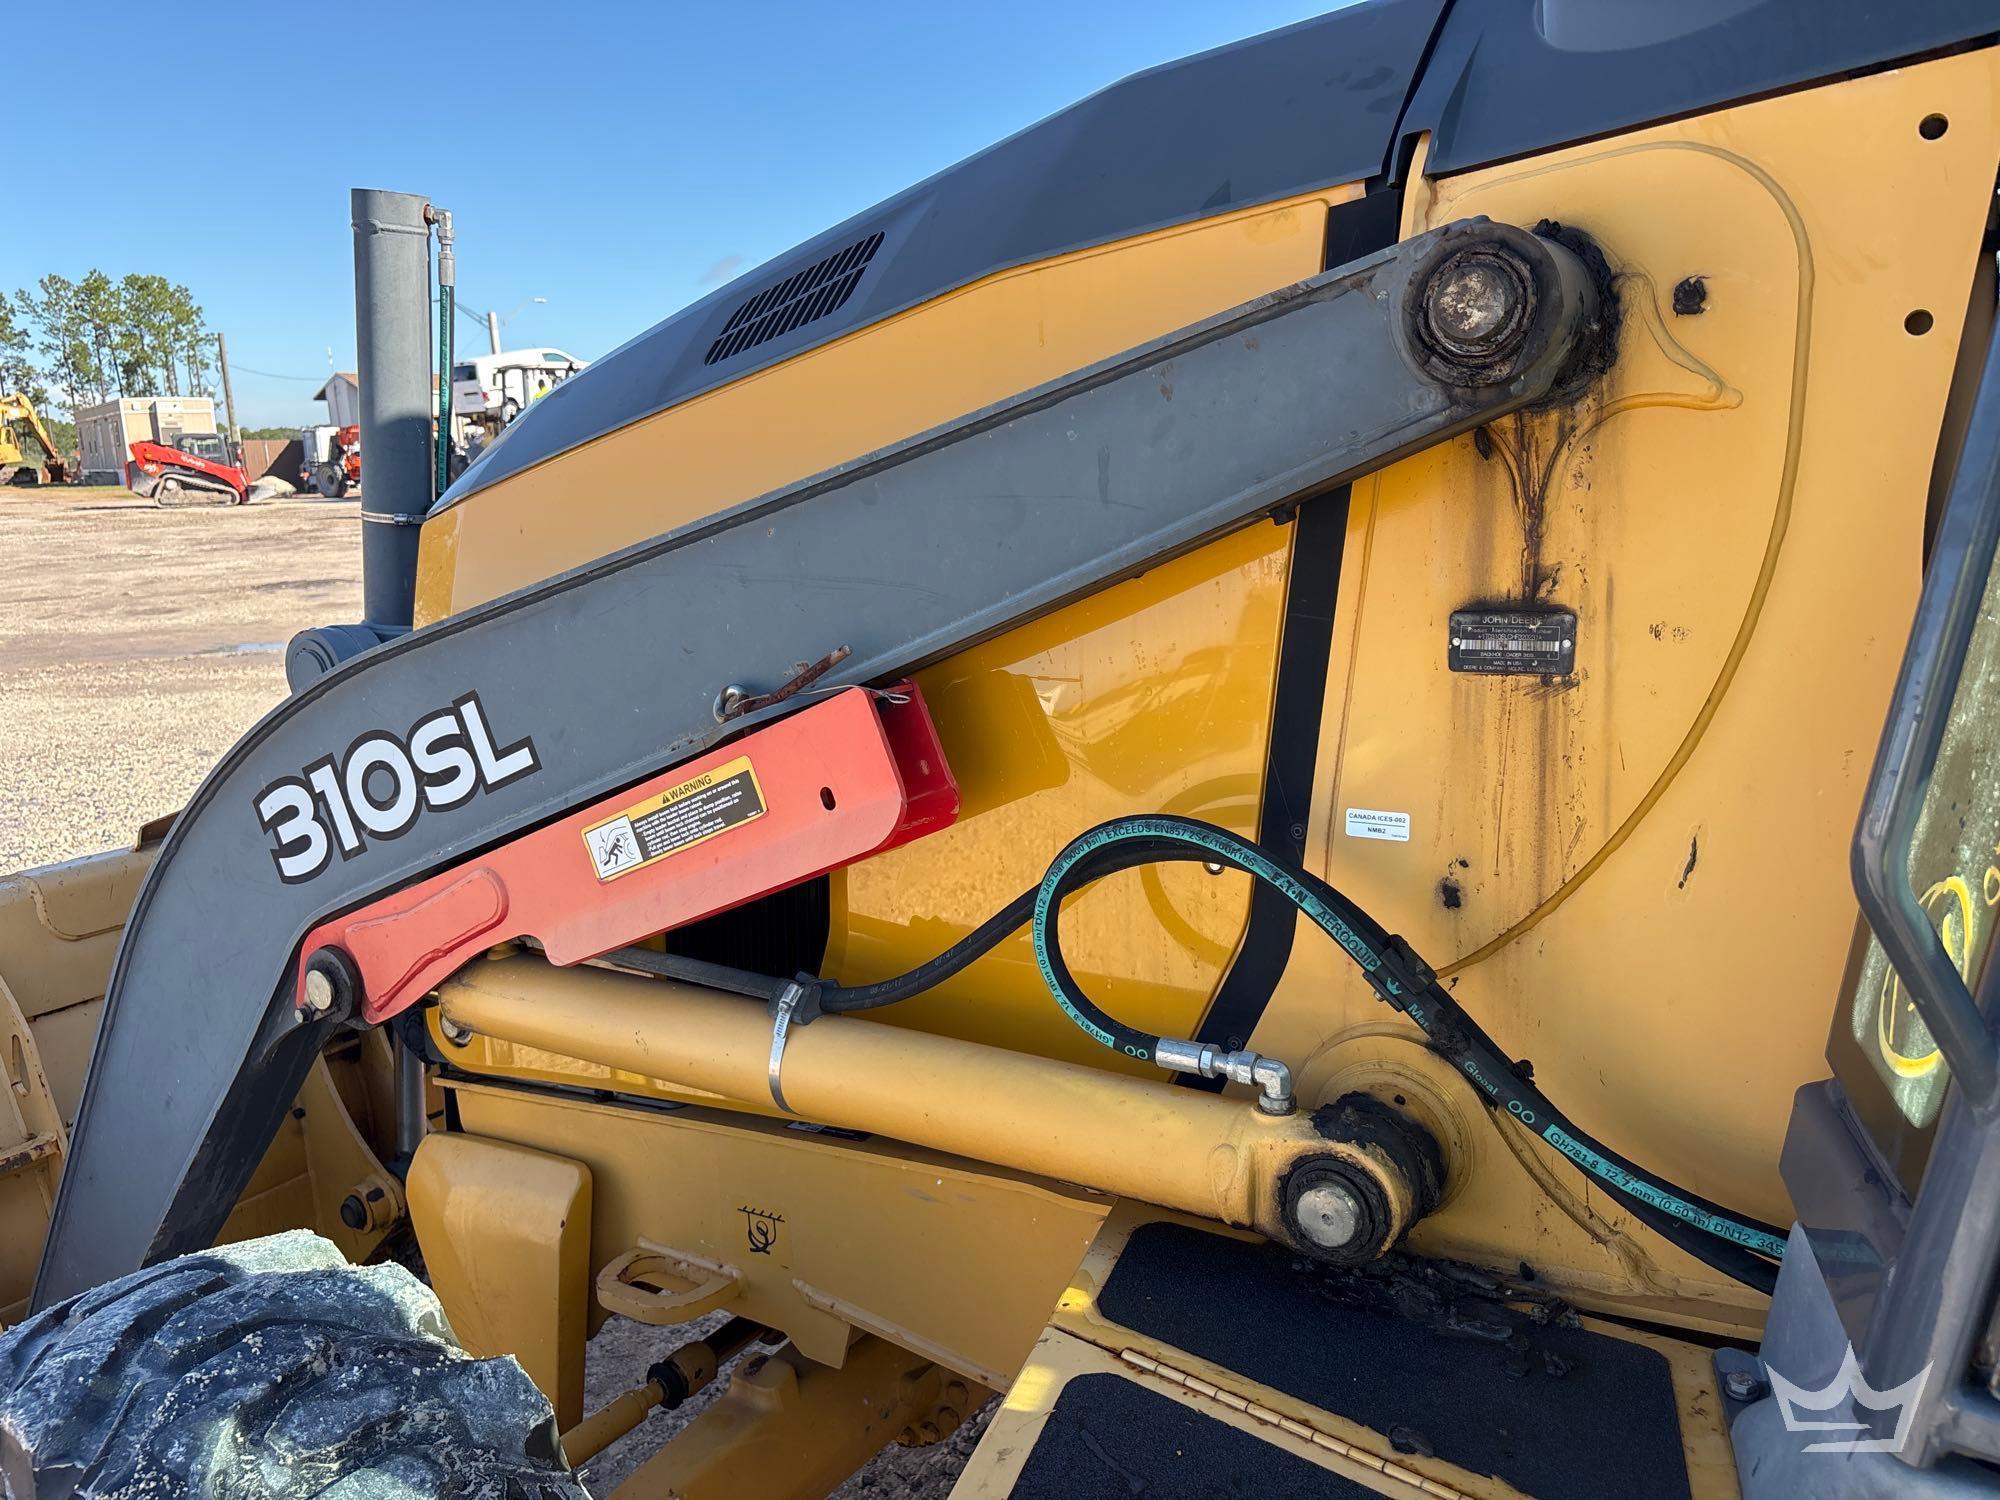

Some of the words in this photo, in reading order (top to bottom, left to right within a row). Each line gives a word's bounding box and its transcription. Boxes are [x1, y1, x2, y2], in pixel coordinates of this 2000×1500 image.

[1482, 616, 1508, 624] JOHN
[1511, 616, 1544, 624] DEERE
[253, 690, 542, 884] 310SL
[670, 774, 712, 800] WARNING
[1348, 812, 1376, 820] CANADA
[1106, 824, 1152, 840] EXCEEDS
[1154, 824, 1186, 839] EN857
[1084, 836, 1102, 849] psi)
[1052, 864, 1066, 877] bar
[1042, 878, 1054, 894] 345
[1036, 898, 1046, 926] DN12
[1316, 909, 1378, 968] AEROQUIP
[1044, 971, 1058, 995] mm
[1055, 993, 1070, 1012] 12.7
[1073, 1012, 1111, 1046] GH781-8
[1464, 1060, 1498, 1096] Global
[1550, 1132, 1598, 1169] GH781-8
[1604, 1168, 1632, 1187] 12.7
[1630, 1184, 1656, 1202] mm
[1714, 1222, 1752, 1244] DN12
[1757, 1238, 1784, 1256] 345
